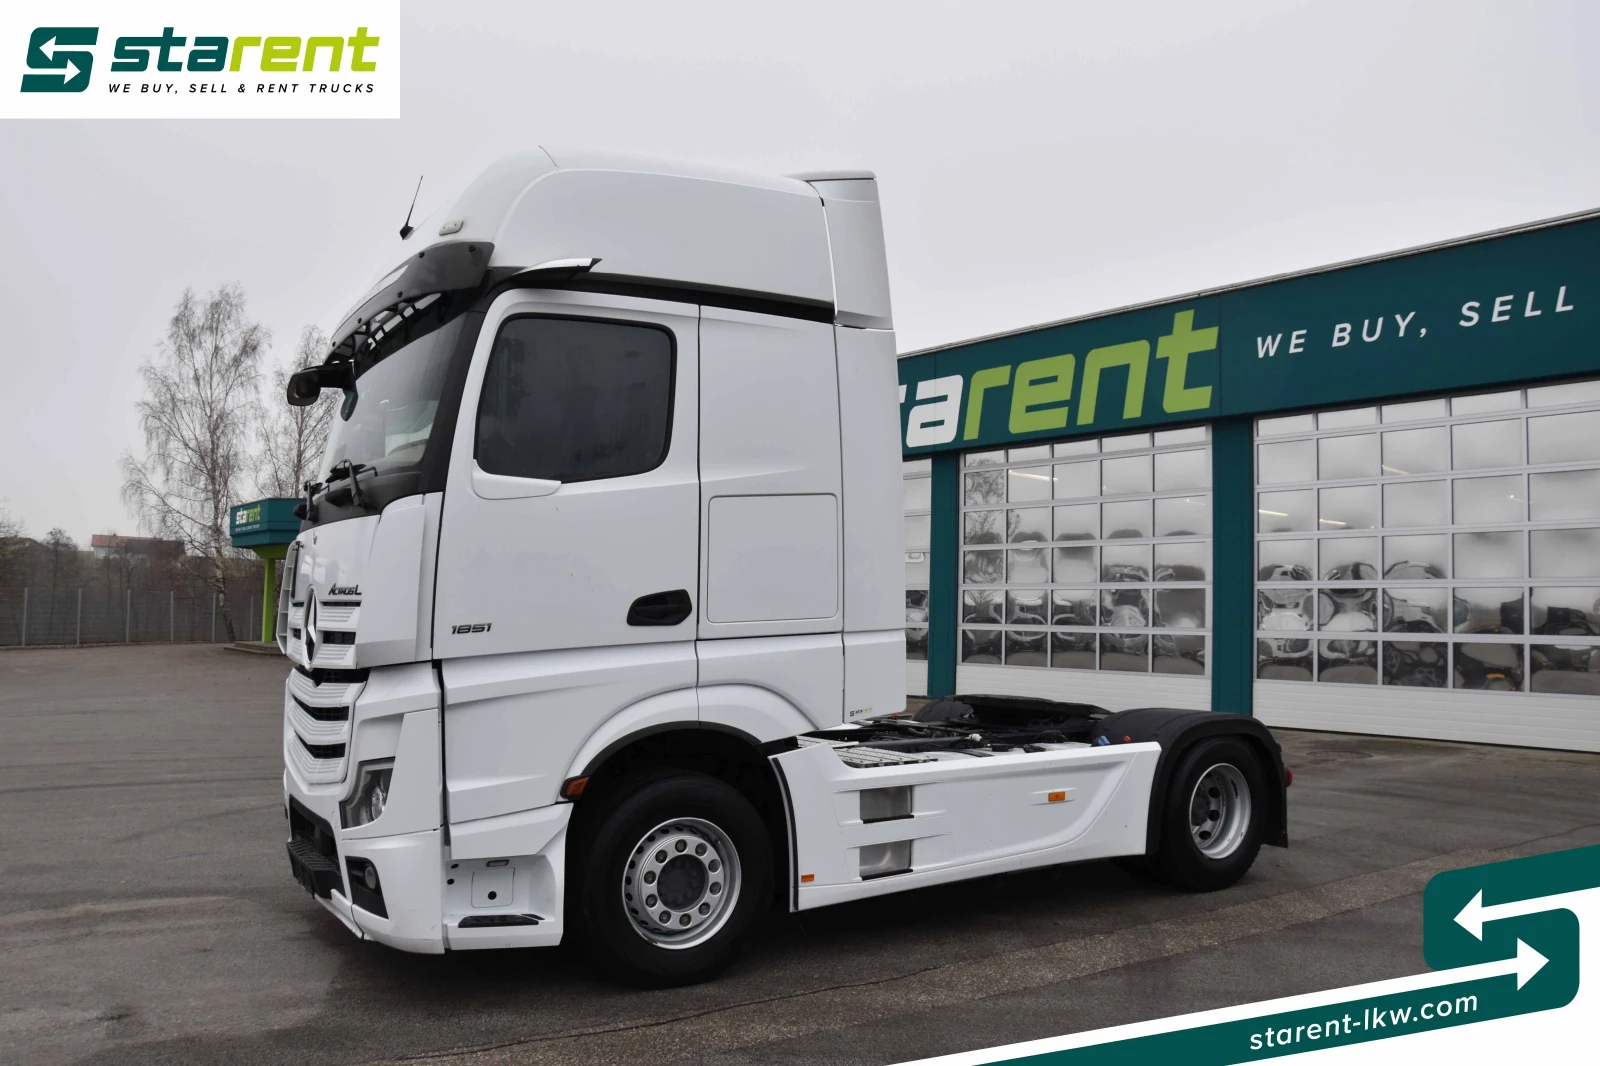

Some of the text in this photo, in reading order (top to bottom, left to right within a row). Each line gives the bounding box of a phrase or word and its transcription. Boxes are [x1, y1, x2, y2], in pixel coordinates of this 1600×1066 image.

[1256, 285, 1574, 359] WE BUY, SELL
[899, 308, 1219, 448] arent
[451, 622, 493, 635] 1851
